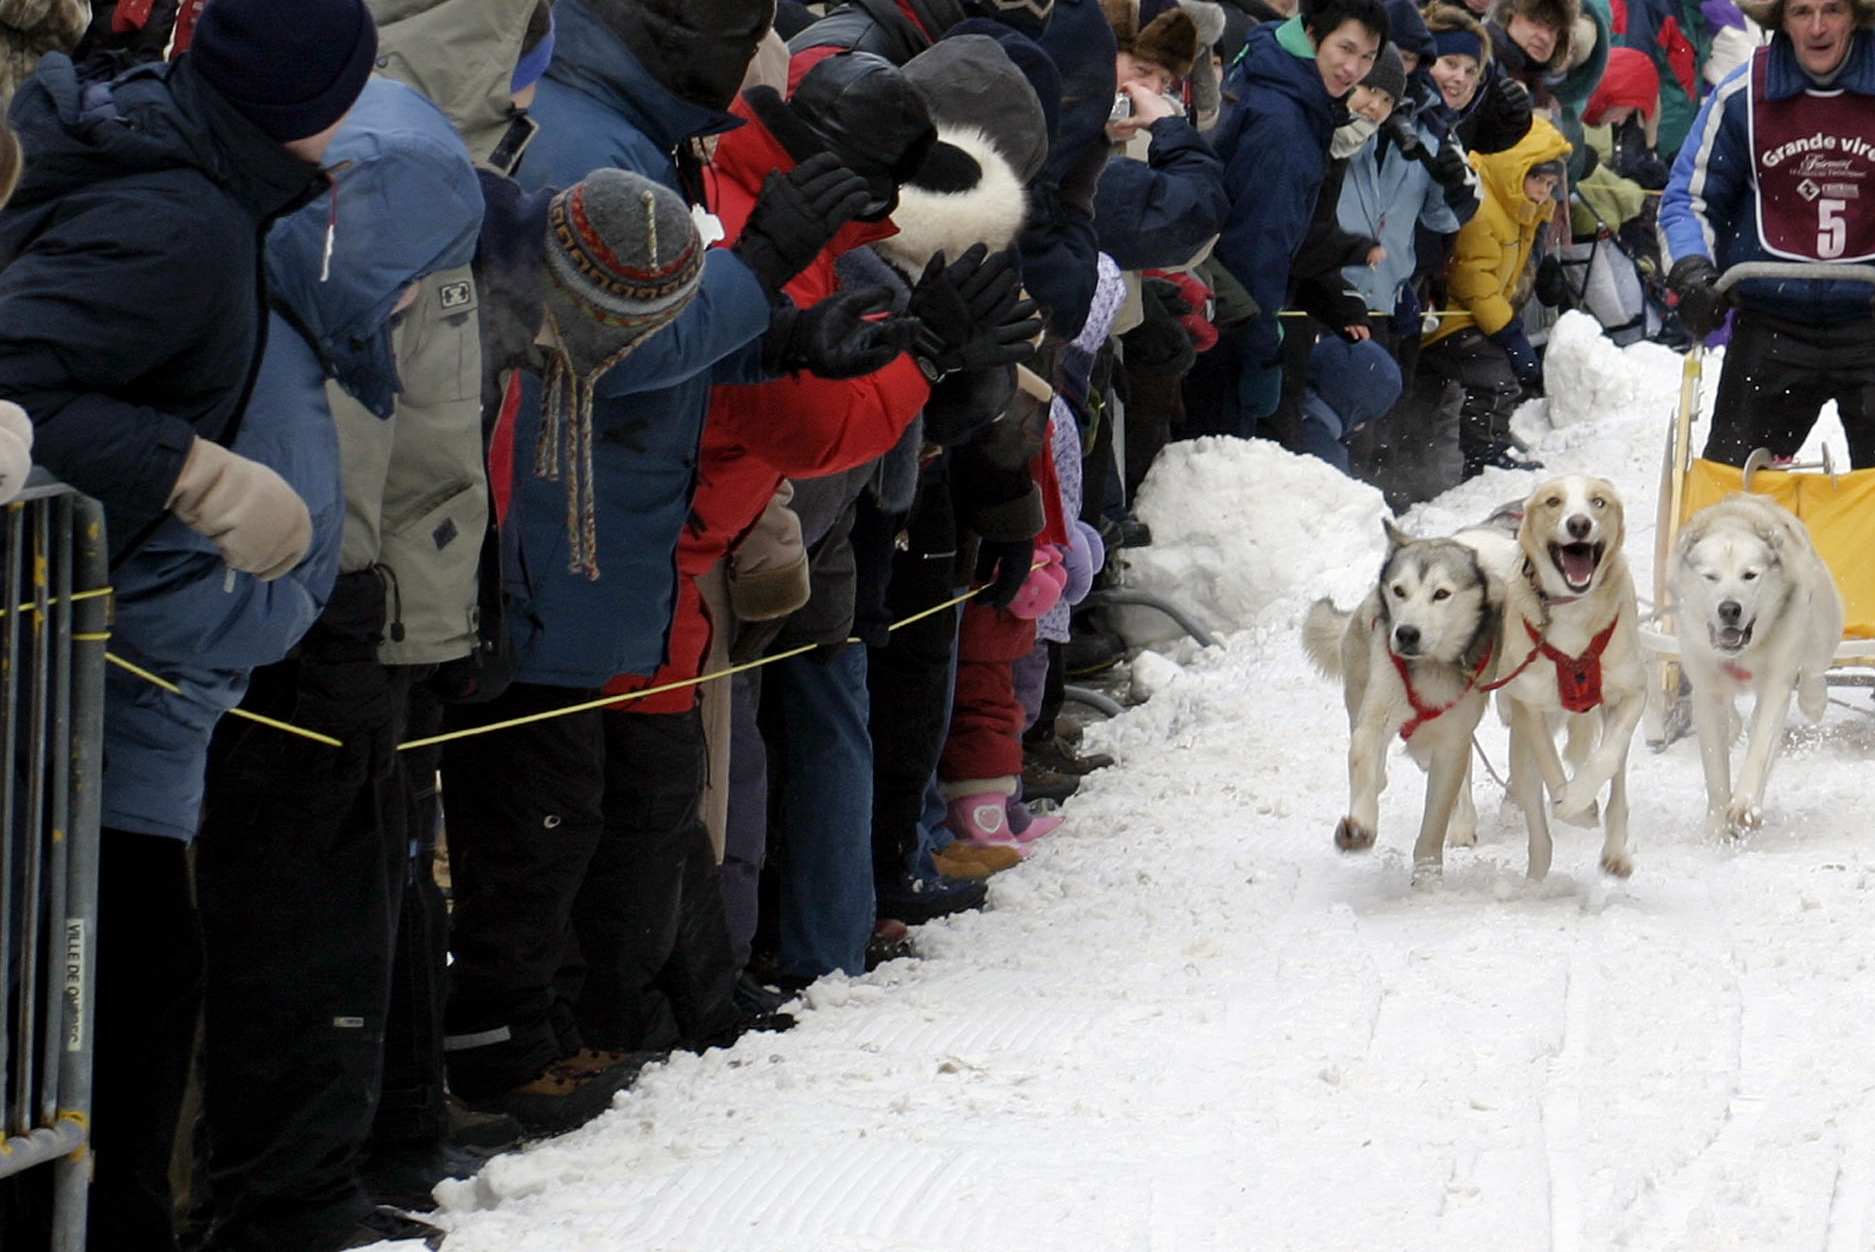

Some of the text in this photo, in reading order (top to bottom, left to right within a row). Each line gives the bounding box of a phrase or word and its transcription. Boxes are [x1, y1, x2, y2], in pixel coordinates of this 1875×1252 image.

[1761, 132, 1836, 168] Grande
[1816, 199, 1847, 259] 5
[67, 924, 81, 961] VILLE
[66, 965, 80, 983] DE
